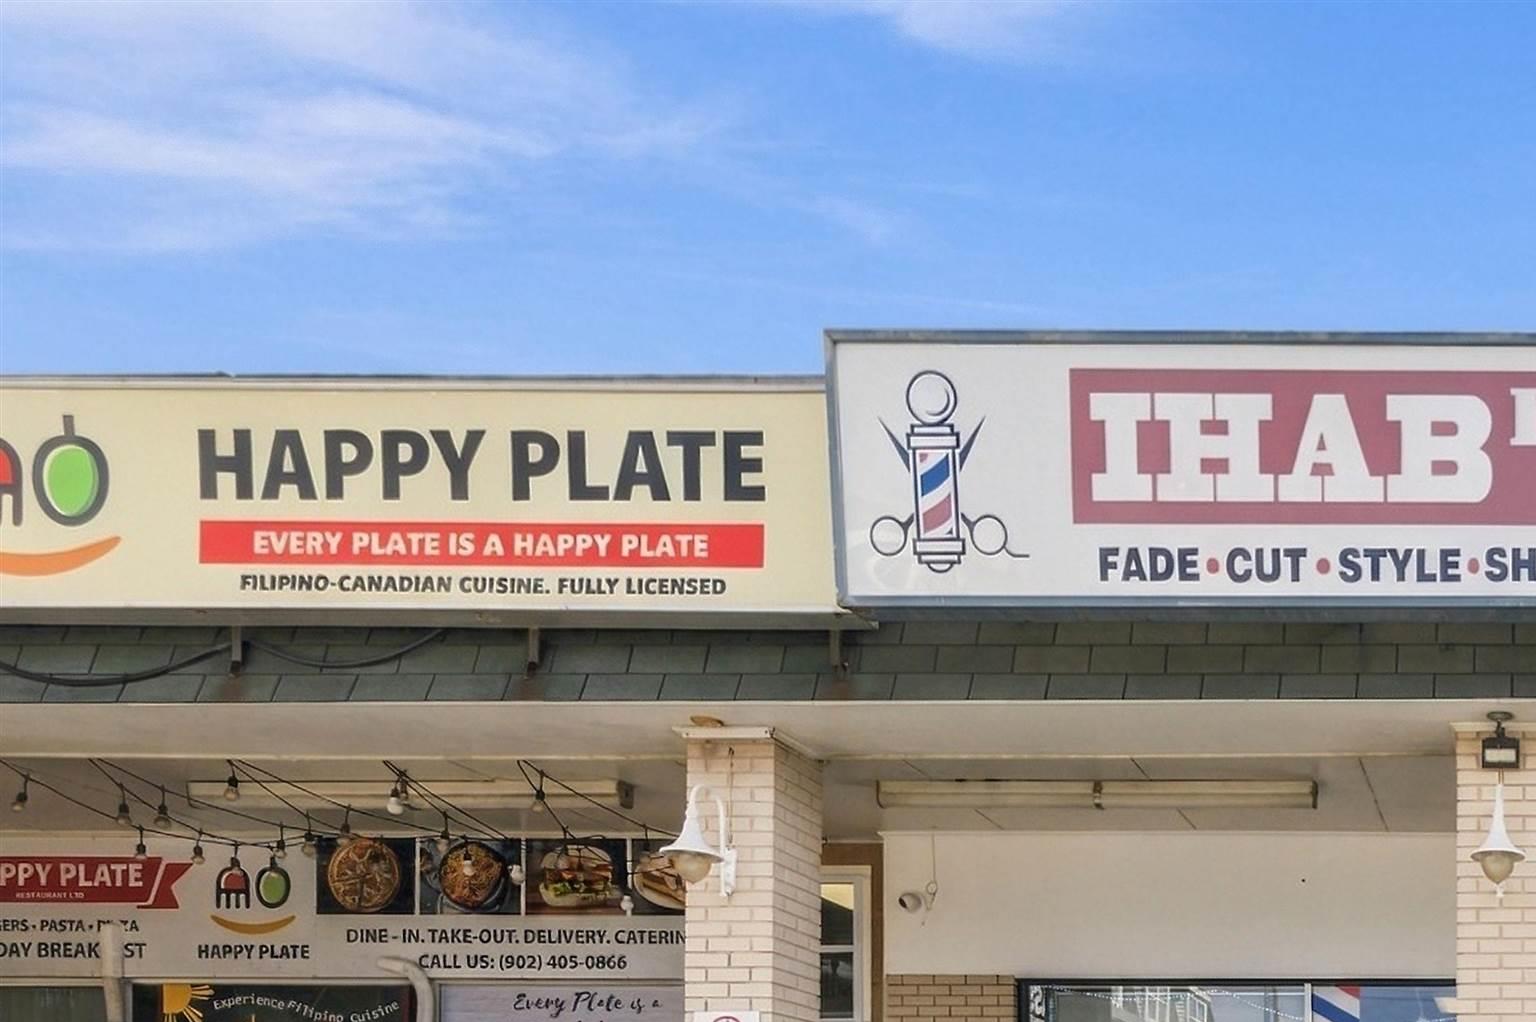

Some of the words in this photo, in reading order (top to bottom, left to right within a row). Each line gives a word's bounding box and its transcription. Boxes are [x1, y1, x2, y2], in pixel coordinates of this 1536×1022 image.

[1090, 392, 1494, 503] IHAB
[198, 428, 485, 501] HAPPY
[510, 429, 767, 502] PLATE
[253, 530, 341, 556] EVERY
[351, 532, 440, 557] PLATE
[449, 533, 475, 557] IS
[482, 533, 507, 557] A
[514, 533, 611, 558] HAPPY
[621, 534, 710, 559] PLATE
[1099, 547, 1201, 583] FADE
[1225, 547, 1308, 583] CUT
[1337, 547, 1462, 583] STYLE
[240, 574, 452, 594] FILIPINO-CANADIAN
[459, 576, 551, 596] CUISINE.
[558, 577, 620, 596] FULLY
[626, 578, 728, 597] LICENSED
[60, 863, 144, 887] PLATE
[16, 891, 67, 899] RESTAURANT
[0, 919, 28, 932] ERS
[40, 919, 86, 932] PASTA
[347, 929, 388, 943] DINE
[402, 929, 425, 944] IN.
[428, 929, 519, 944] TAKE-OUT.
[524, 929, 611, 944] DELIVERY.
[38, 942, 147, 959] BREAKST
[198, 945, 256, 959] HAPPY
[259, 945, 310, 959] PLATE
[418, 954, 462, 970] CALL
[466, 955, 495, 970] US:
[499, 955, 542, 972] (902)
[547, 955, 627, 970] 405-0866
[213, 993, 285, 1010] Experience
[350, 1000, 400, 1022] Cuisine
[513, 992, 566, 1019] Every
[572, 991, 624, 1012] Plate
[630, 999, 645, 1014] is
[652, 1000, 662, 1008] a
